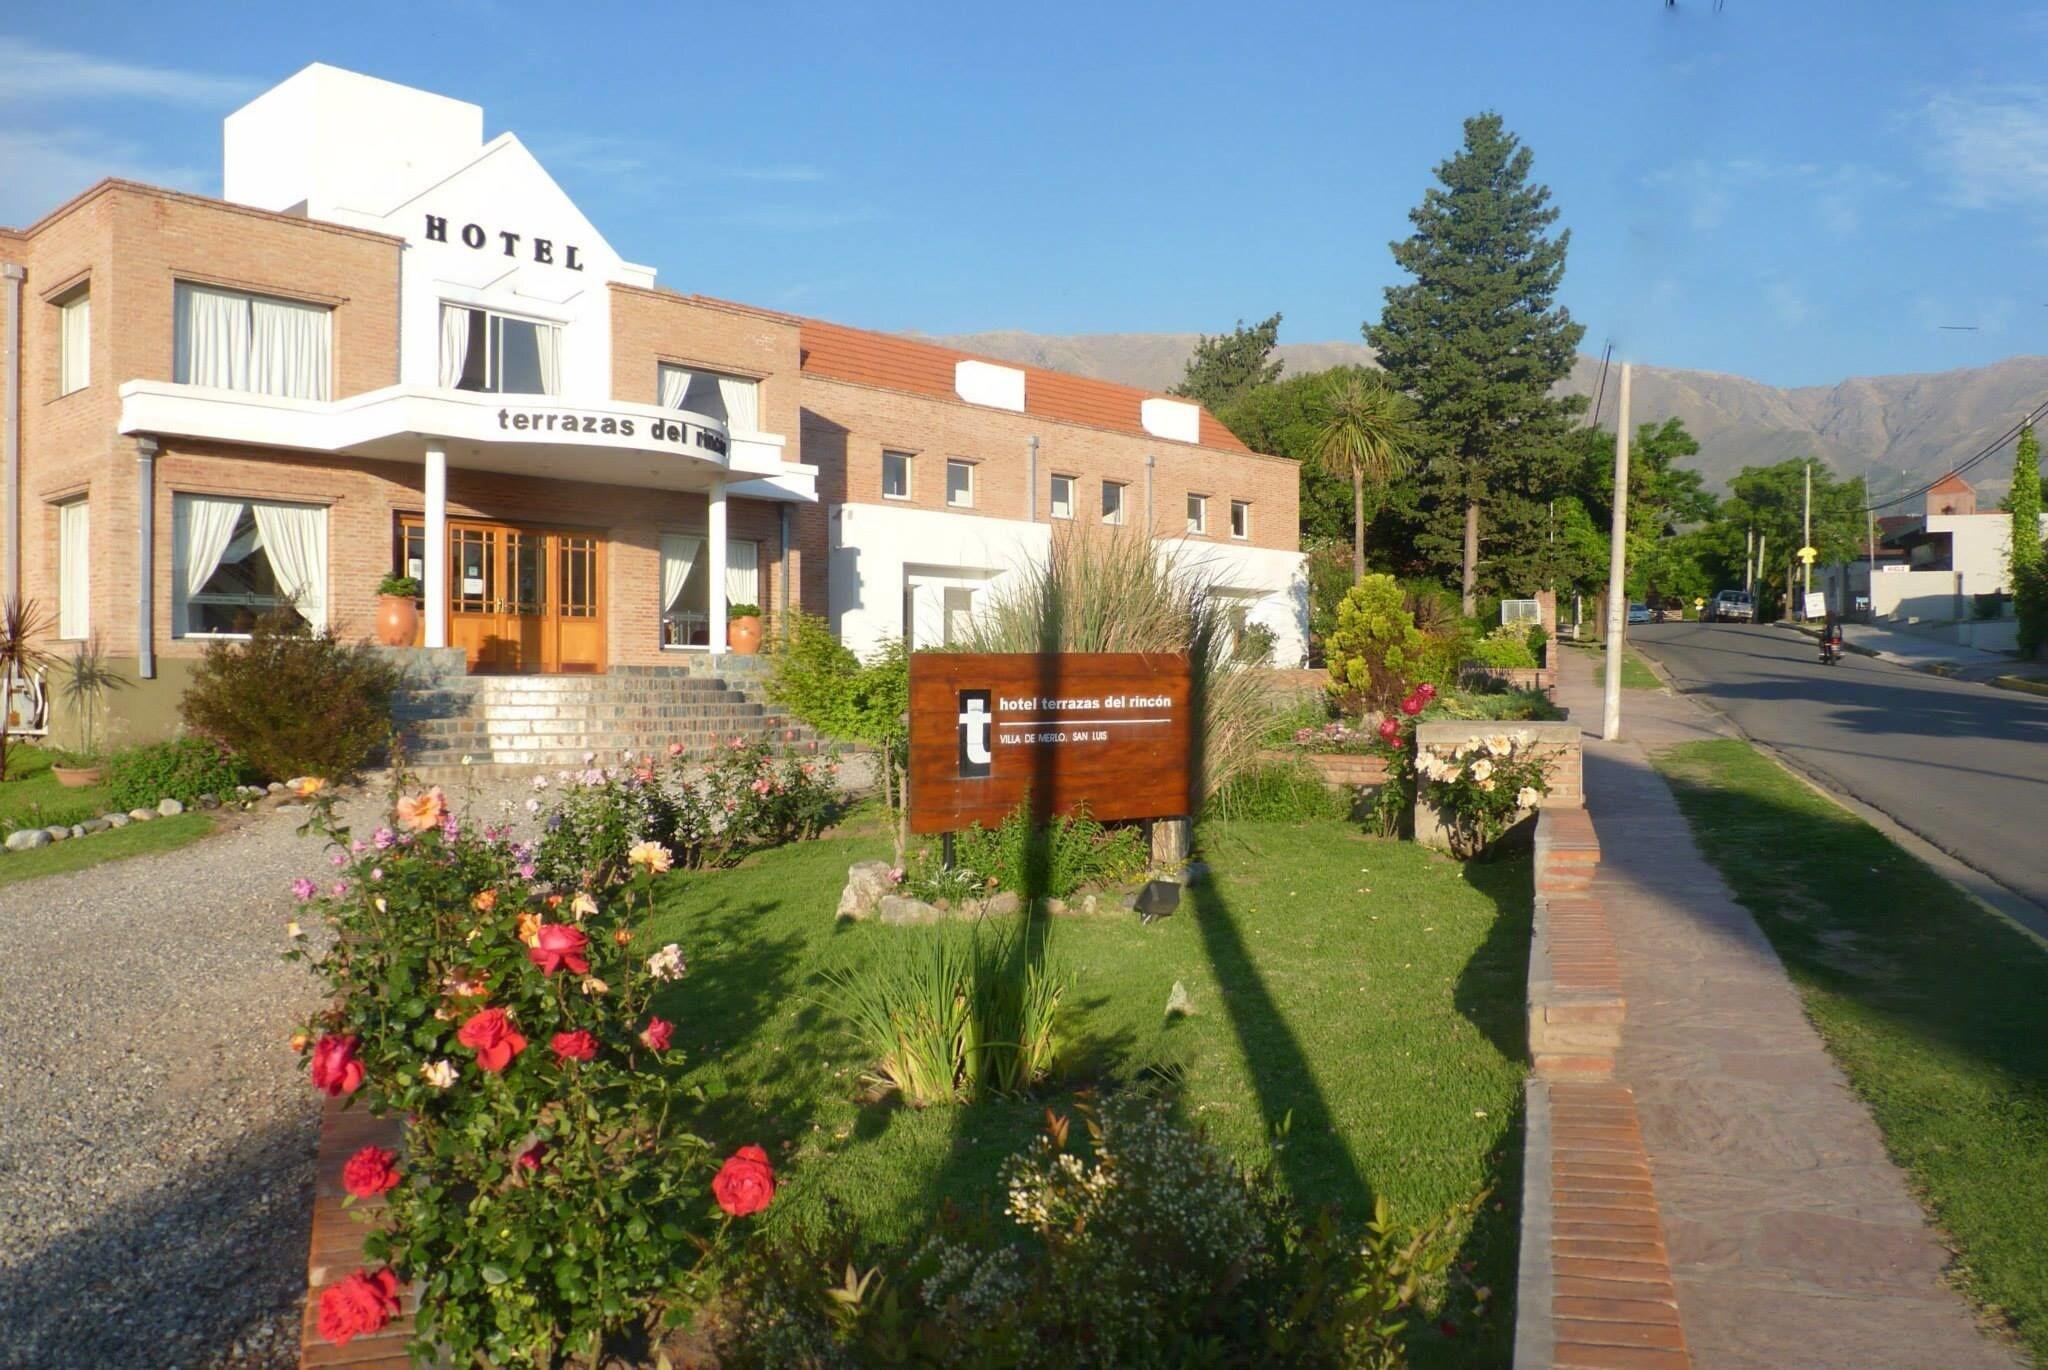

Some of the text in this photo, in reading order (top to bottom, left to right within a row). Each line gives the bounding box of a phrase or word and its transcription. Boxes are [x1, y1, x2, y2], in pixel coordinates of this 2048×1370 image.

[425, 214, 583, 271] HOTEL
[498, 408, 634, 436] terrazas
[651, 418, 687, 444] del
[999, 694, 1172, 711] hotel terrazas del rincón
[1000, 734, 1020, 744] VILLA
[1024, 733, 1036, 743] DE
[1072, 731, 1088, 742] SAN
[1092, 731, 1107, 741] LUIS
